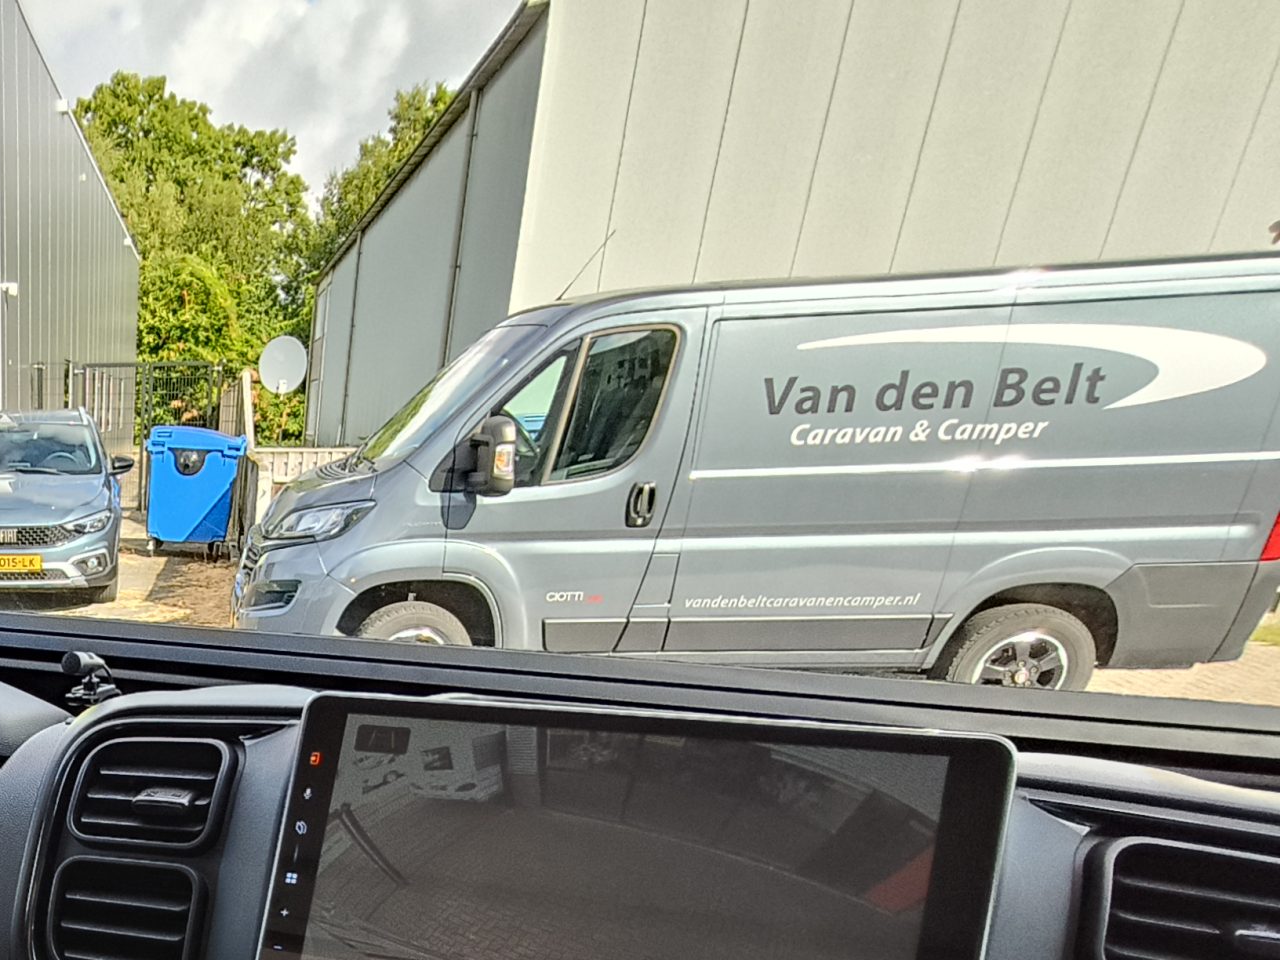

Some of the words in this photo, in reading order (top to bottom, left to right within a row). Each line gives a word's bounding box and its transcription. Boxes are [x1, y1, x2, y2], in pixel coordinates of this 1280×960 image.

[764, 376, 857, 415] Van
[875, 370, 975, 412] den
[992, 362, 1106, 408] Belt
[790, 423, 903, 446] Caravan
[909, 420, 931, 442] &
[938, 419, 1049, 445] Camper
[0, 528, 18, 543] FIAT
[685, 593, 922, 609] vandenbeltcaravanencamper.nl
